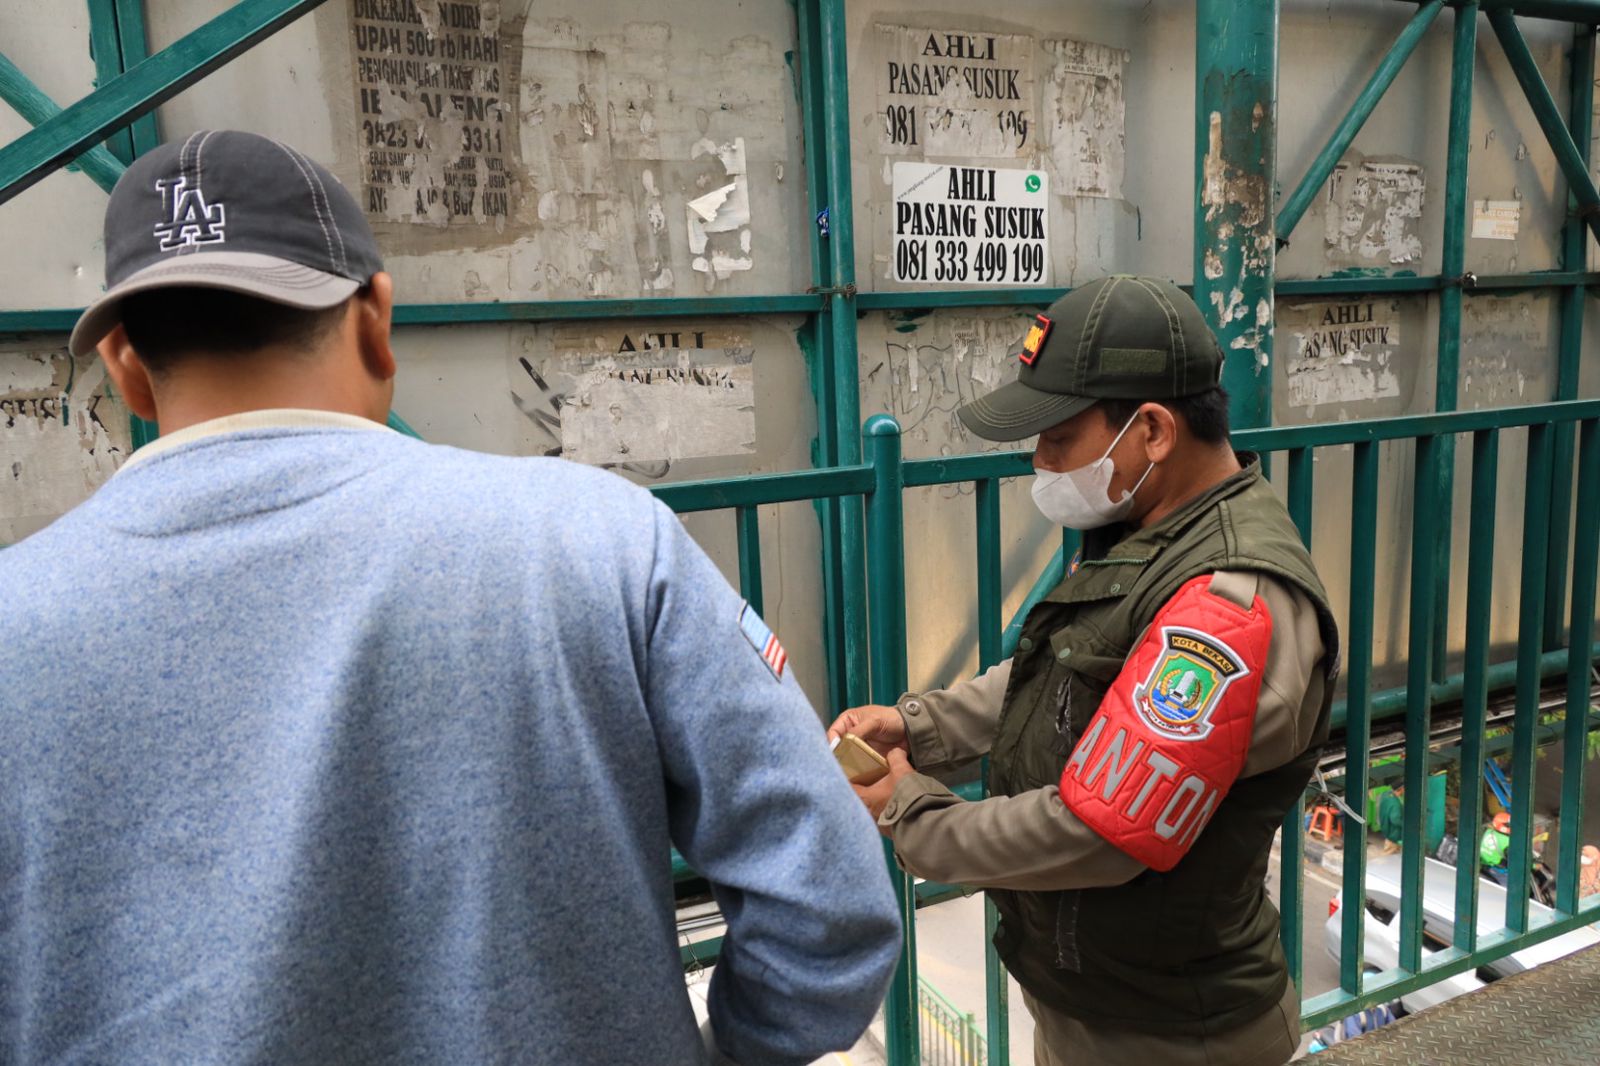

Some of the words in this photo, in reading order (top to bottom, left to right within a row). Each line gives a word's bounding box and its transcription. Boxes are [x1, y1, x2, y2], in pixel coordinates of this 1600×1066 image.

[355, 26, 401, 54] UPAH
[406, 30, 435, 57] 500
[922, 33, 996, 61] AHLI
[886, 105, 918, 146] 081
[947, 167, 996, 202] AHLI
[153, 176, 226, 252] LA
[896, 201, 977, 238] PASANG
[985, 206, 1046, 240] SUSUK
[897, 239, 928, 281] 081
[935, 240, 968, 282] 333
[973, 242, 1008, 283] 499
[1012, 243, 1044, 283] 199
[1321, 303, 1374, 326] AHLI
[1302, 330, 1348, 358] ASANG
[1172, 636, 1199, 652] KOTA
[1202, 646, 1233, 672] BEKASI
[1064, 715, 1220, 847] ANTON
